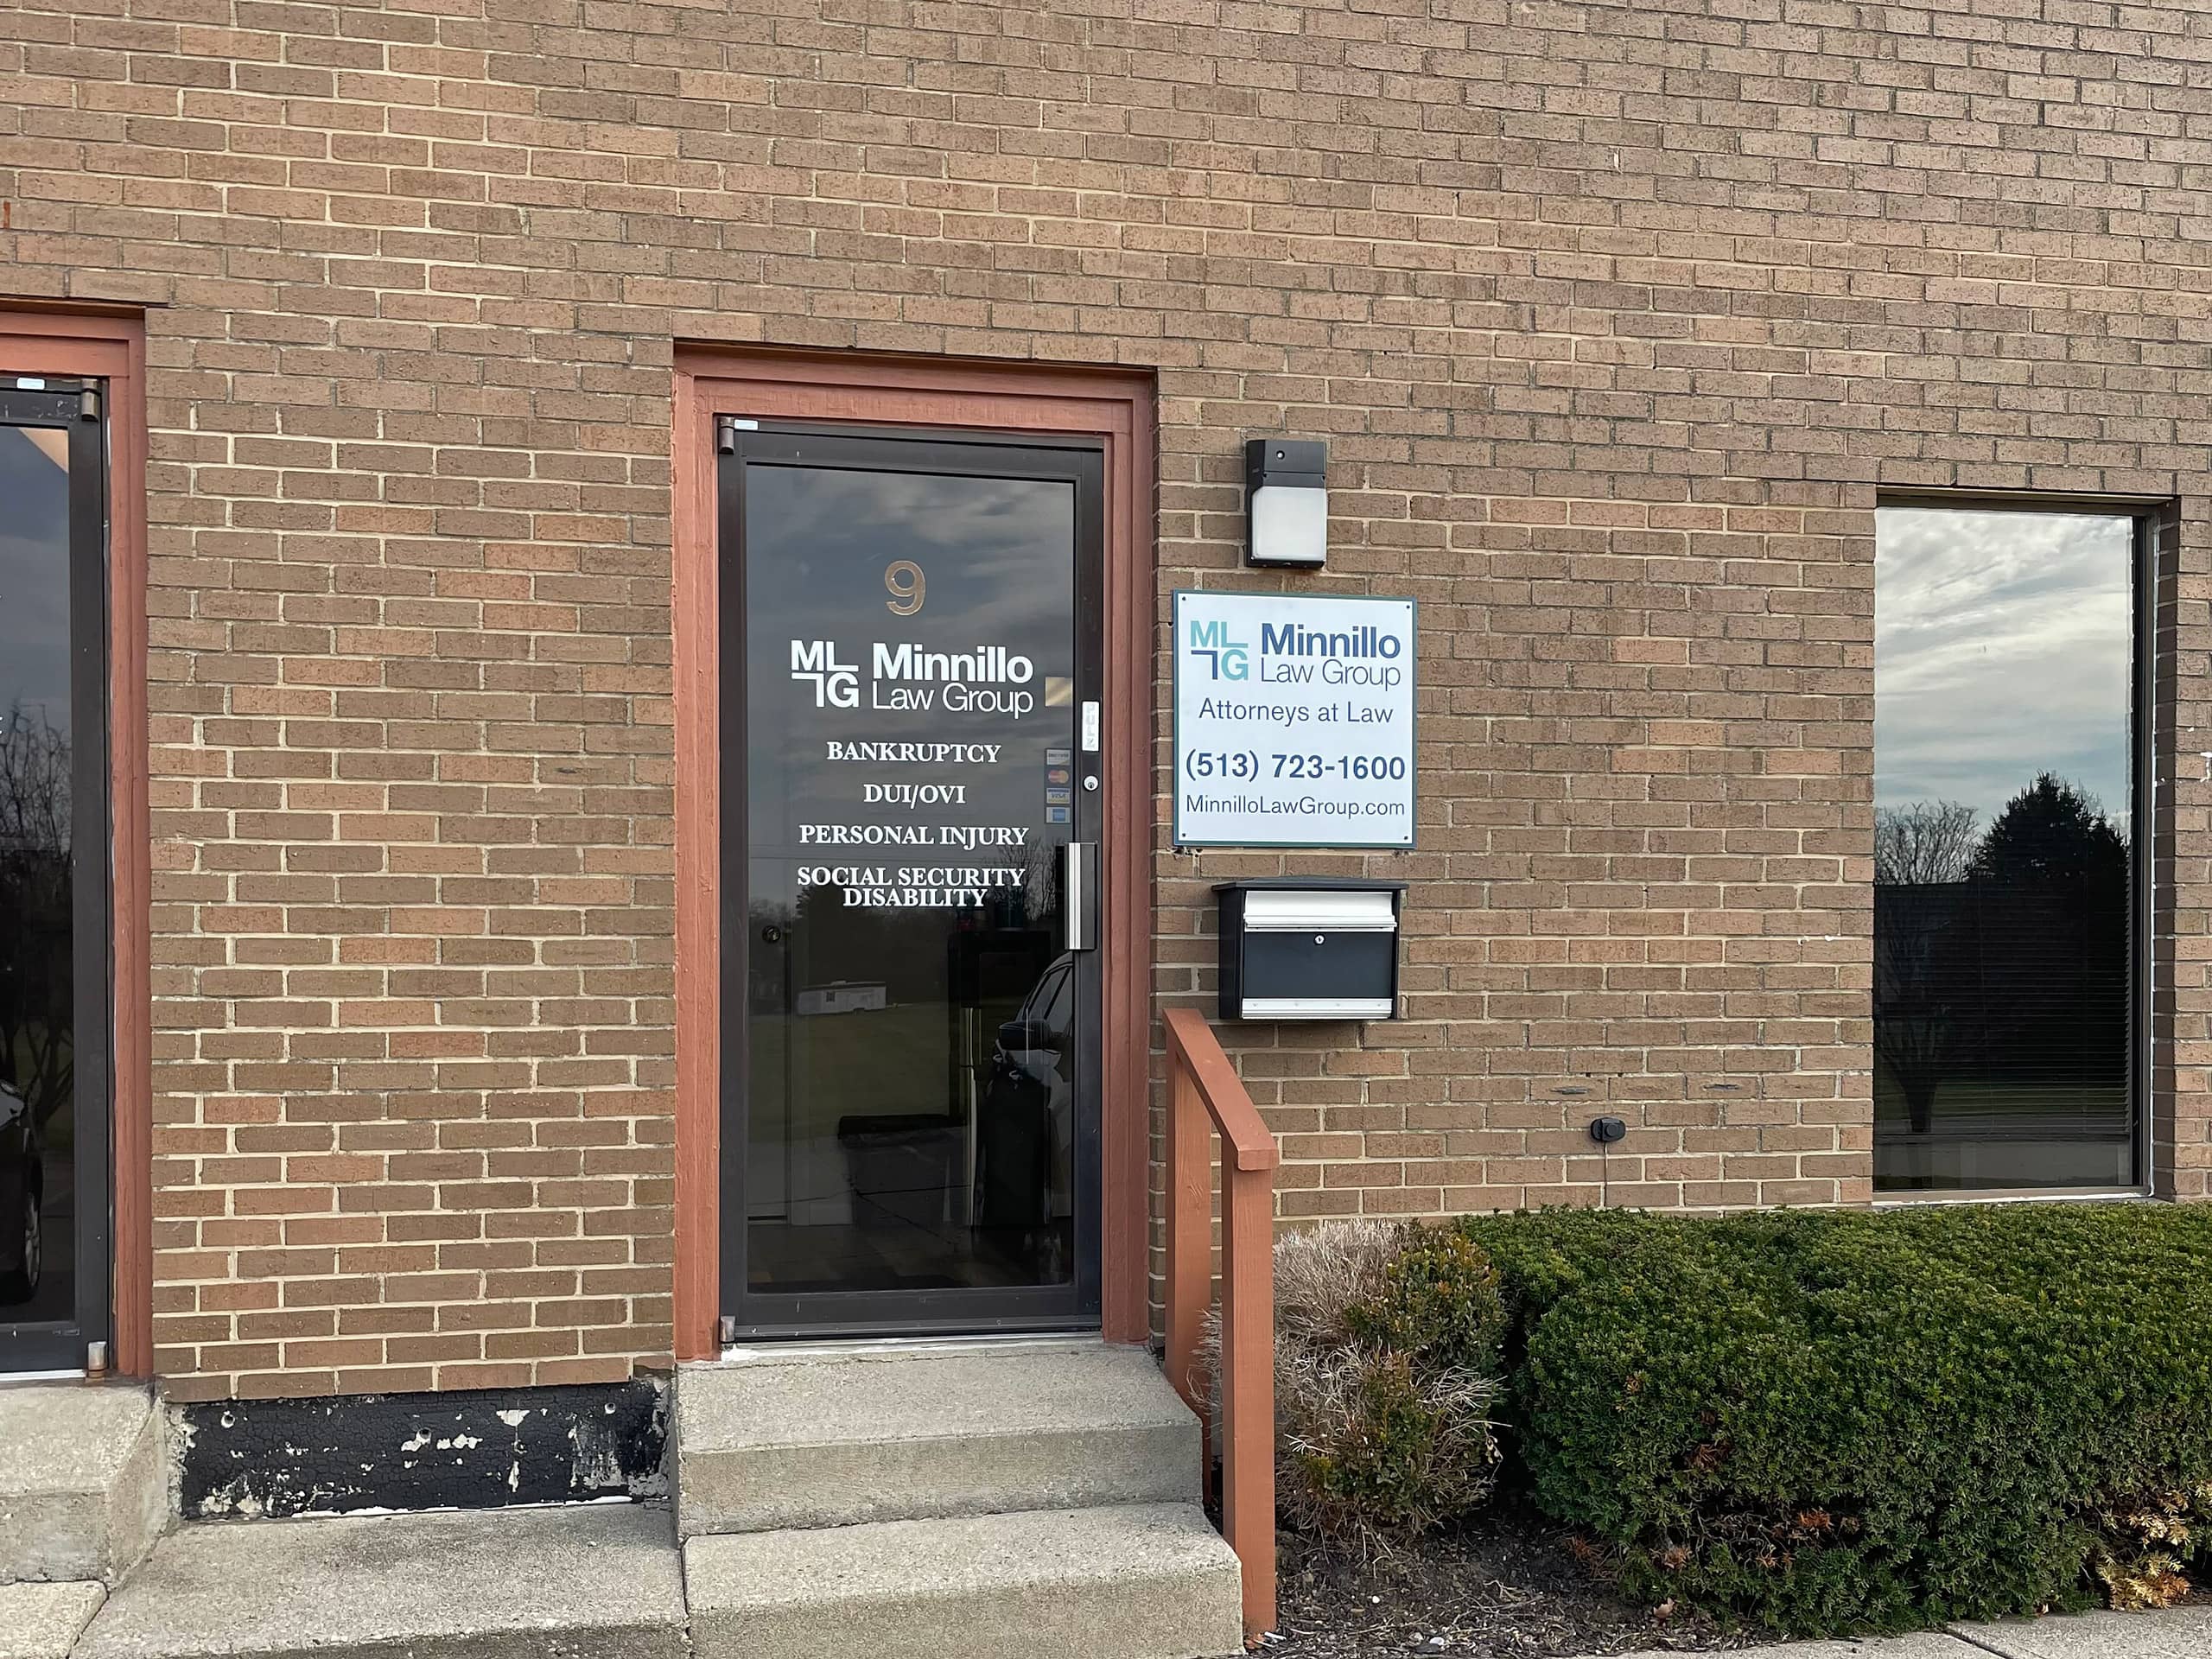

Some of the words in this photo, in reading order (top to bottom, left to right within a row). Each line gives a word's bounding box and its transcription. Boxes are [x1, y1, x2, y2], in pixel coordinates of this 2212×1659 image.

[884, 560, 925, 615] 9
[1262, 623, 1401, 658] Minnillo
[873, 642, 1033, 683] Minnillo
[1261, 657, 1314, 683] Law
[1322, 659, 1401, 691] Group
[872, 681, 934, 711] Law
[943, 683, 1033, 719] Group
[1198, 697, 1309, 727] Attorneys
[1318, 702, 1338, 722] at
[1348, 701, 1394, 722] Law
[826, 741, 1001, 764] BANKRUPTCY
[1186, 749, 1259, 782] (513)
[1272, 754, 1405, 779] 723-1600
[864, 784, 966, 809] DUI/OVI
[1186, 795, 1404, 819] MinnilloLawGroup.com
[799, 824, 934, 845] PERSONAL
[940, 827, 1029, 850] INJURY
[798, 866, 892, 887] SOCIAL
[898, 867, 1026, 887] SECURITY
[842, 887, 988, 907] DISABILITY
